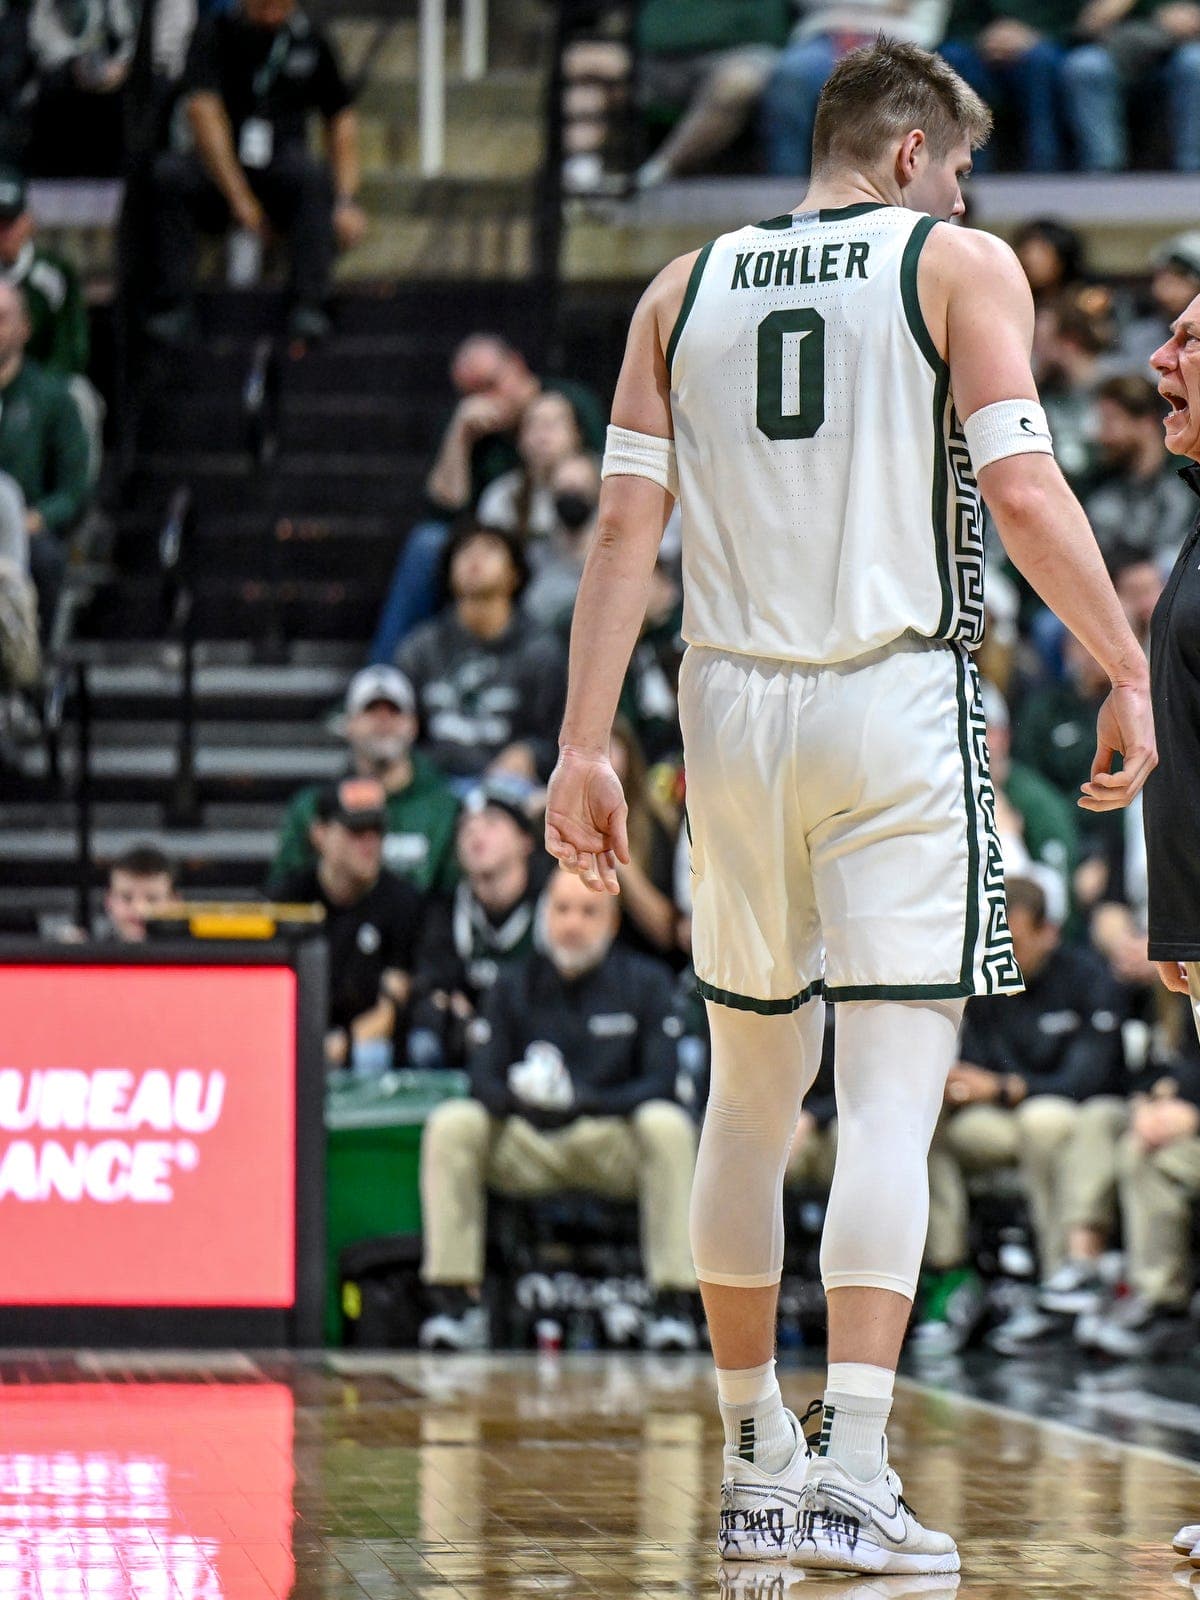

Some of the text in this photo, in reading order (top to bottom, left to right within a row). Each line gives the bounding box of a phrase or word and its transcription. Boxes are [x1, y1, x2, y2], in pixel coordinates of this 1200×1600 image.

[731, 241, 870, 290] KOHLER
[757, 307, 825, 440] 0
[0, 1069, 225, 1132] UREAU
